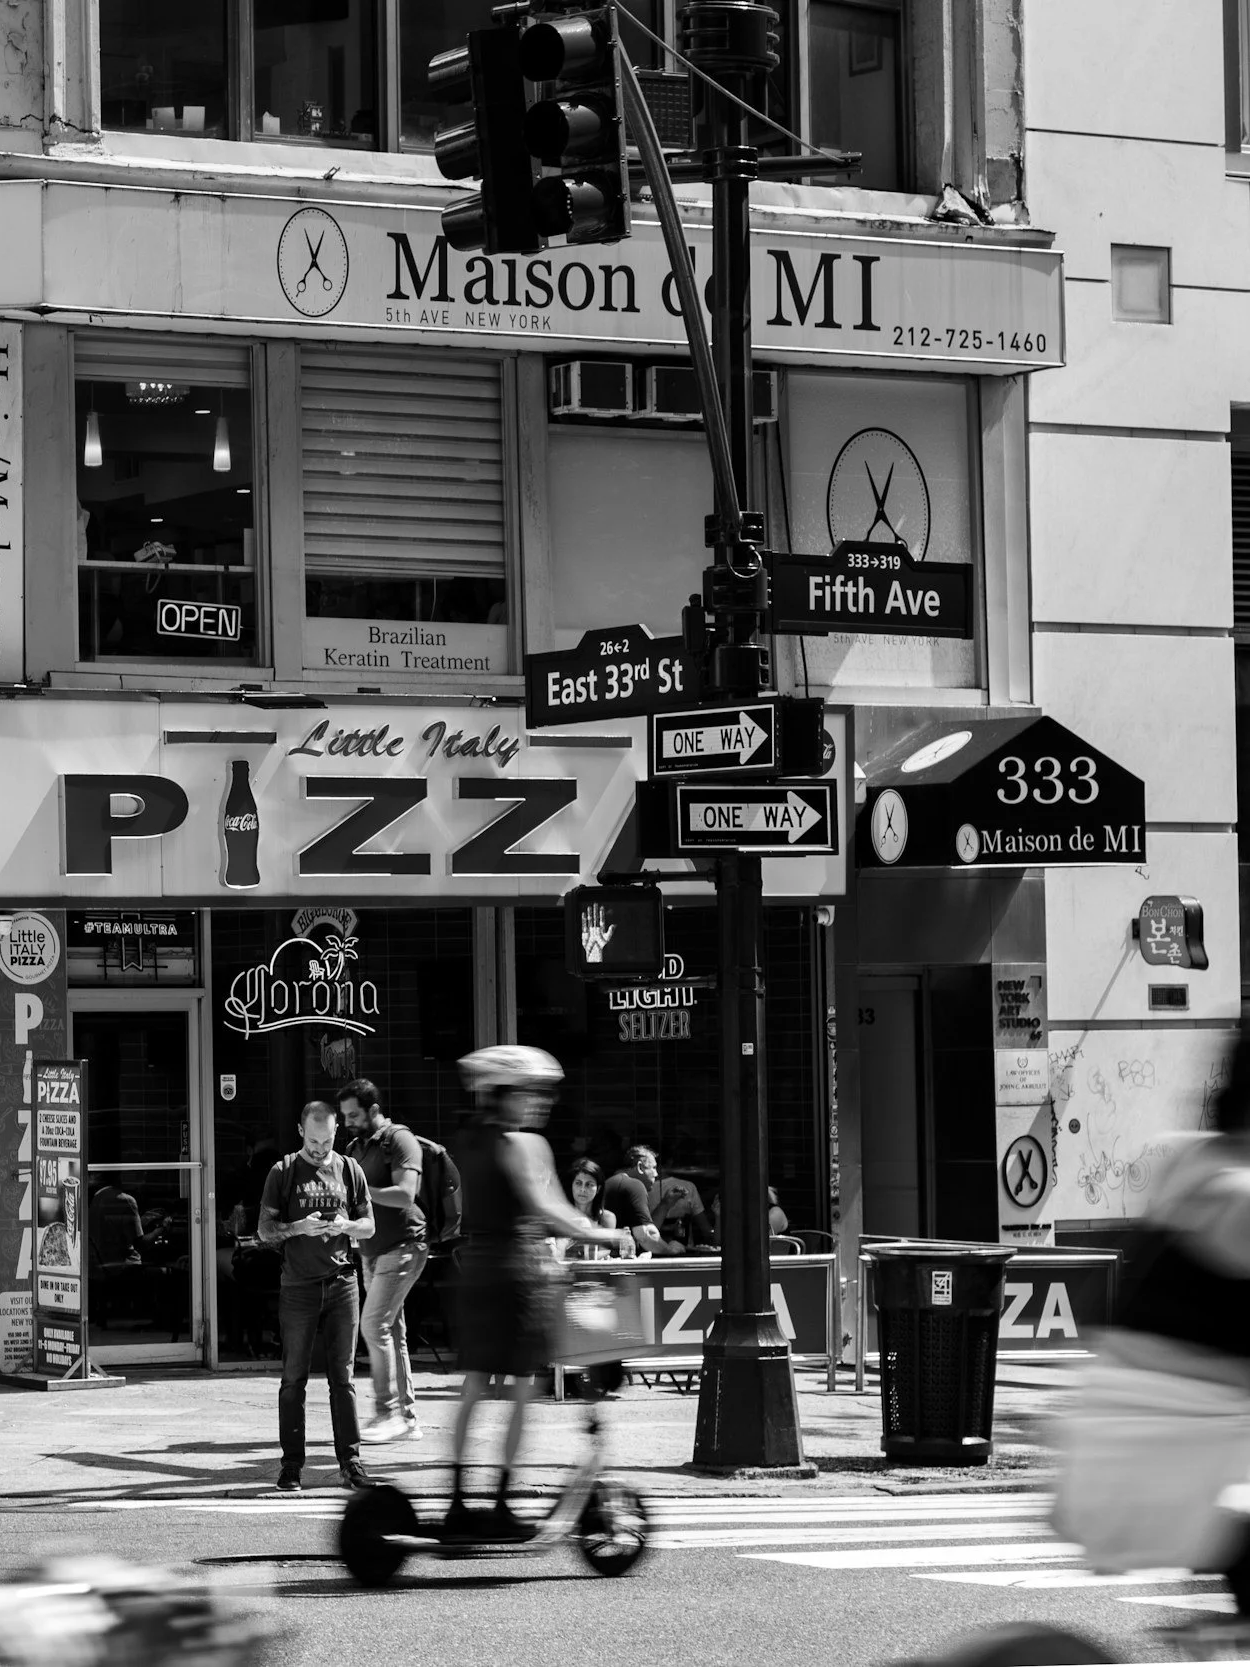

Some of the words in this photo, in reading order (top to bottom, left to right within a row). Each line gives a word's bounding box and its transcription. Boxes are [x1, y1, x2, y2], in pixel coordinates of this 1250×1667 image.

[387, 232, 639, 314] Maison
[767, 249, 881, 332] MI
[386, 308, 411, 322] 5th
[420, 309, 449, 325] AVE
[465, 311, 502, 326] NEW
[510, 312, 551, 330] YORK
[893, 326, 1047, 353] 212-725-1460
[848, 553, 870, 568] 333
[879, 555, 901, 570] 319
[809, 575, 876, 614] Fifth
[884, 581, 941, 618] Ave
[161, 603, 237, 637] OPEN
[368, 626, 447, 647] Brazilian
[600, 641, 614, 656] 26
[623, 639, 630, 653] 2
[324, 648, 390, 669] Keratin
[401, 651, 491, 672] Treatment
[547, 666, 598, 706] East
[605, 658, 650, 699] 33rd
[658, 658, 683, 693] St
[289, 720, 404, 758] Little
[423, 722, 523, 768] Italy
[673, 731, 704, 754] ONE
[720, 726, 755, 750] WAY
[997, 756, 1099, 804] 333
[703, 806, 743, 828] ONE
[763, 806, 807, 828] WAY
[981, 826, 1062, 854] Maison
[1069, 826, 1095, 851] de
[1103, 825, 1141, 853] MI
[10, 930, 46, 943] Little
[83, 922, 179, 936] #TEAMULTRA
[10, 943, 46, 956] ITALY
[10, 956, 46, 966] PIZZA
[998, 981, 1025, 990] NEW
[225, 965, 380, 1040] Corona
[999, 993, 1030, 1003] YORK
[999, 1005, 1020, 1015] ART
[619, 1009, 691, 1041] SELTZER
[999, 1018, 1040, 1028] STUDIO
[37, 1081, 80, 1104] PIZZA
[0, 1308, 29, 1316] LOCATIONS
[10, 1297, 23, 1305] VISIT
